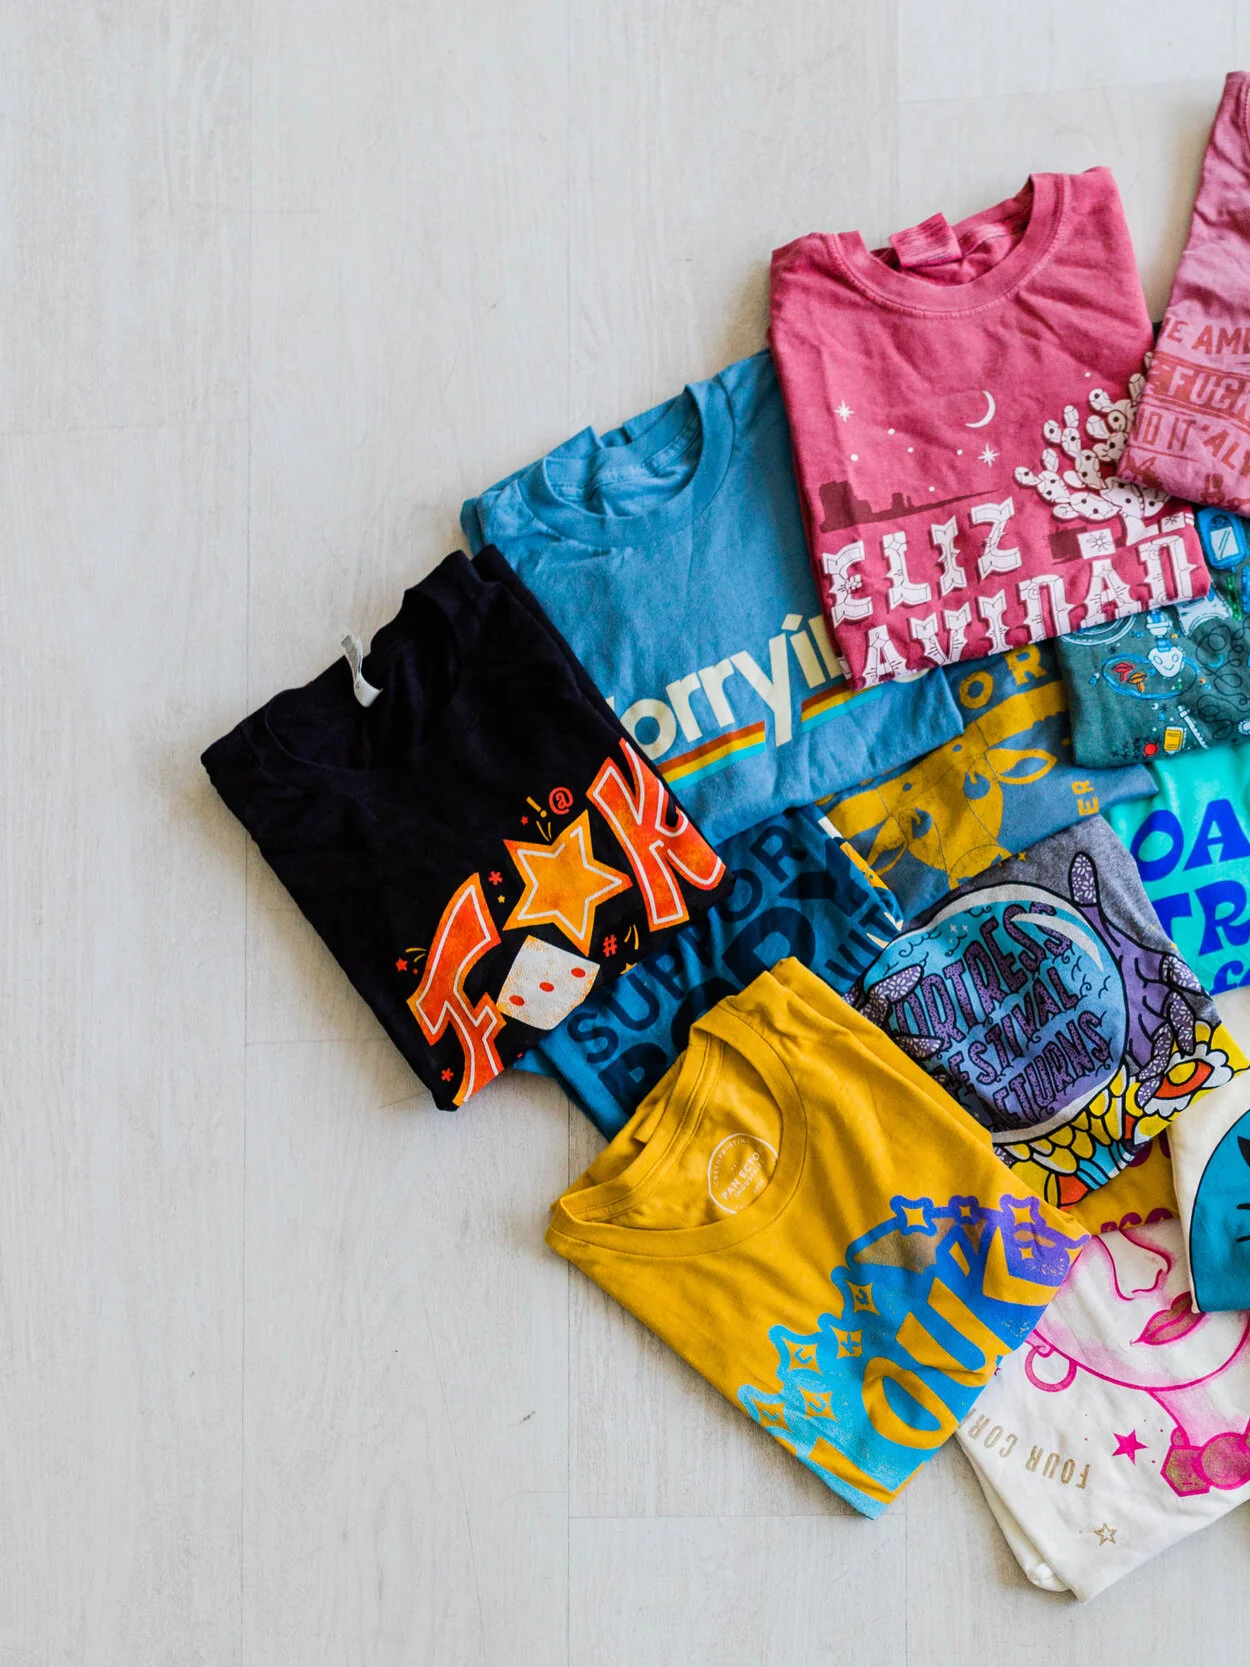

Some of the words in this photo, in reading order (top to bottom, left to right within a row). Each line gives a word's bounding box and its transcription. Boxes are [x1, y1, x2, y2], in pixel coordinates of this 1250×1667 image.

[1167, 416, 1197, 452] IT
[821, 496, 1021, 628] ELIZ
[836, 534, 1197, 692] AVIDAD
[604, 613, 900, 747] orryi
[893, 901, 1073, 1050] ORTRESS
[945, 965, 1082, 1092] ESTIVAL
[992, 1010, 1112, 1126] ETURNS
[1024, 1444, 1091, 1491] FOUR
